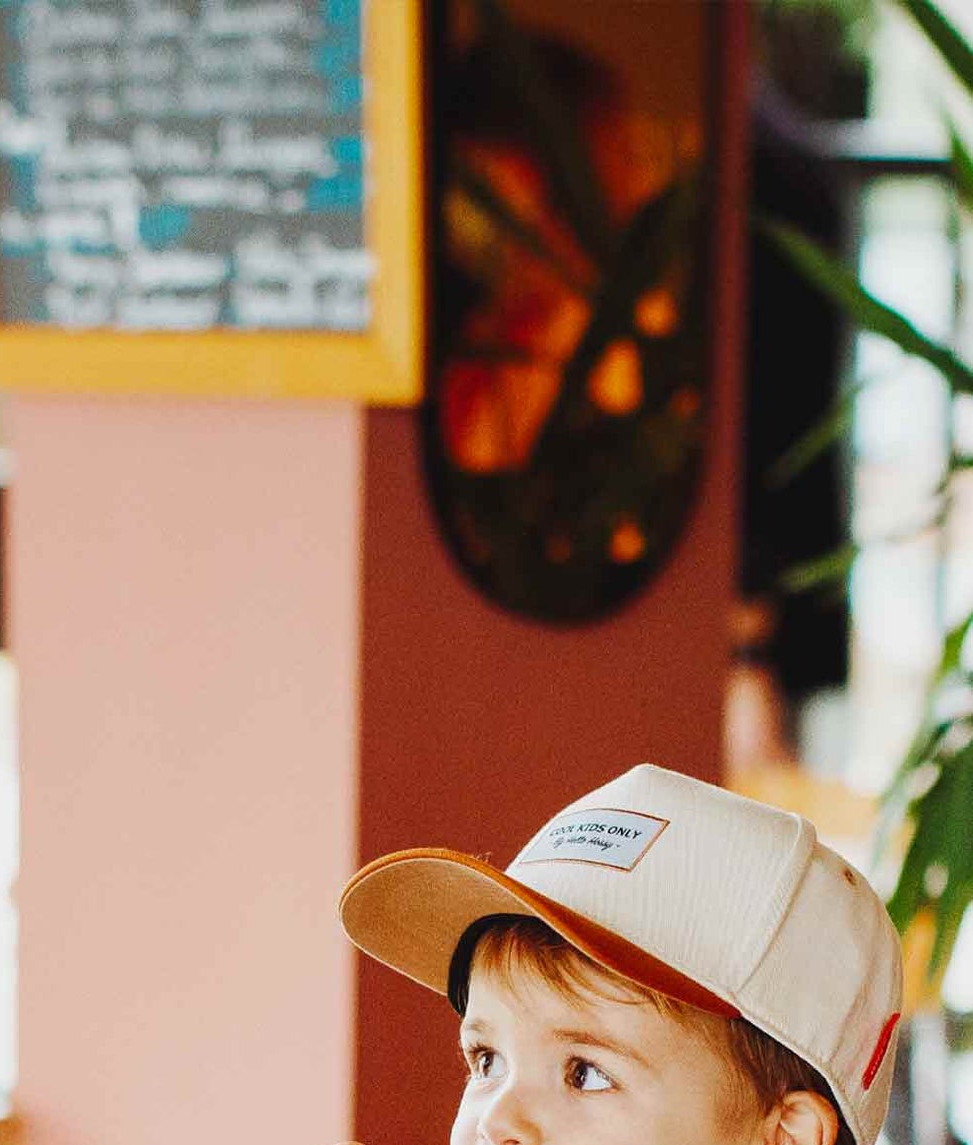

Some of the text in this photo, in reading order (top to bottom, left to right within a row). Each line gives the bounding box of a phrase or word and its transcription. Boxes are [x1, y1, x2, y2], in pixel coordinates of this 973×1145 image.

[549, 823, 642, 839] COOL KIDS ONLY
